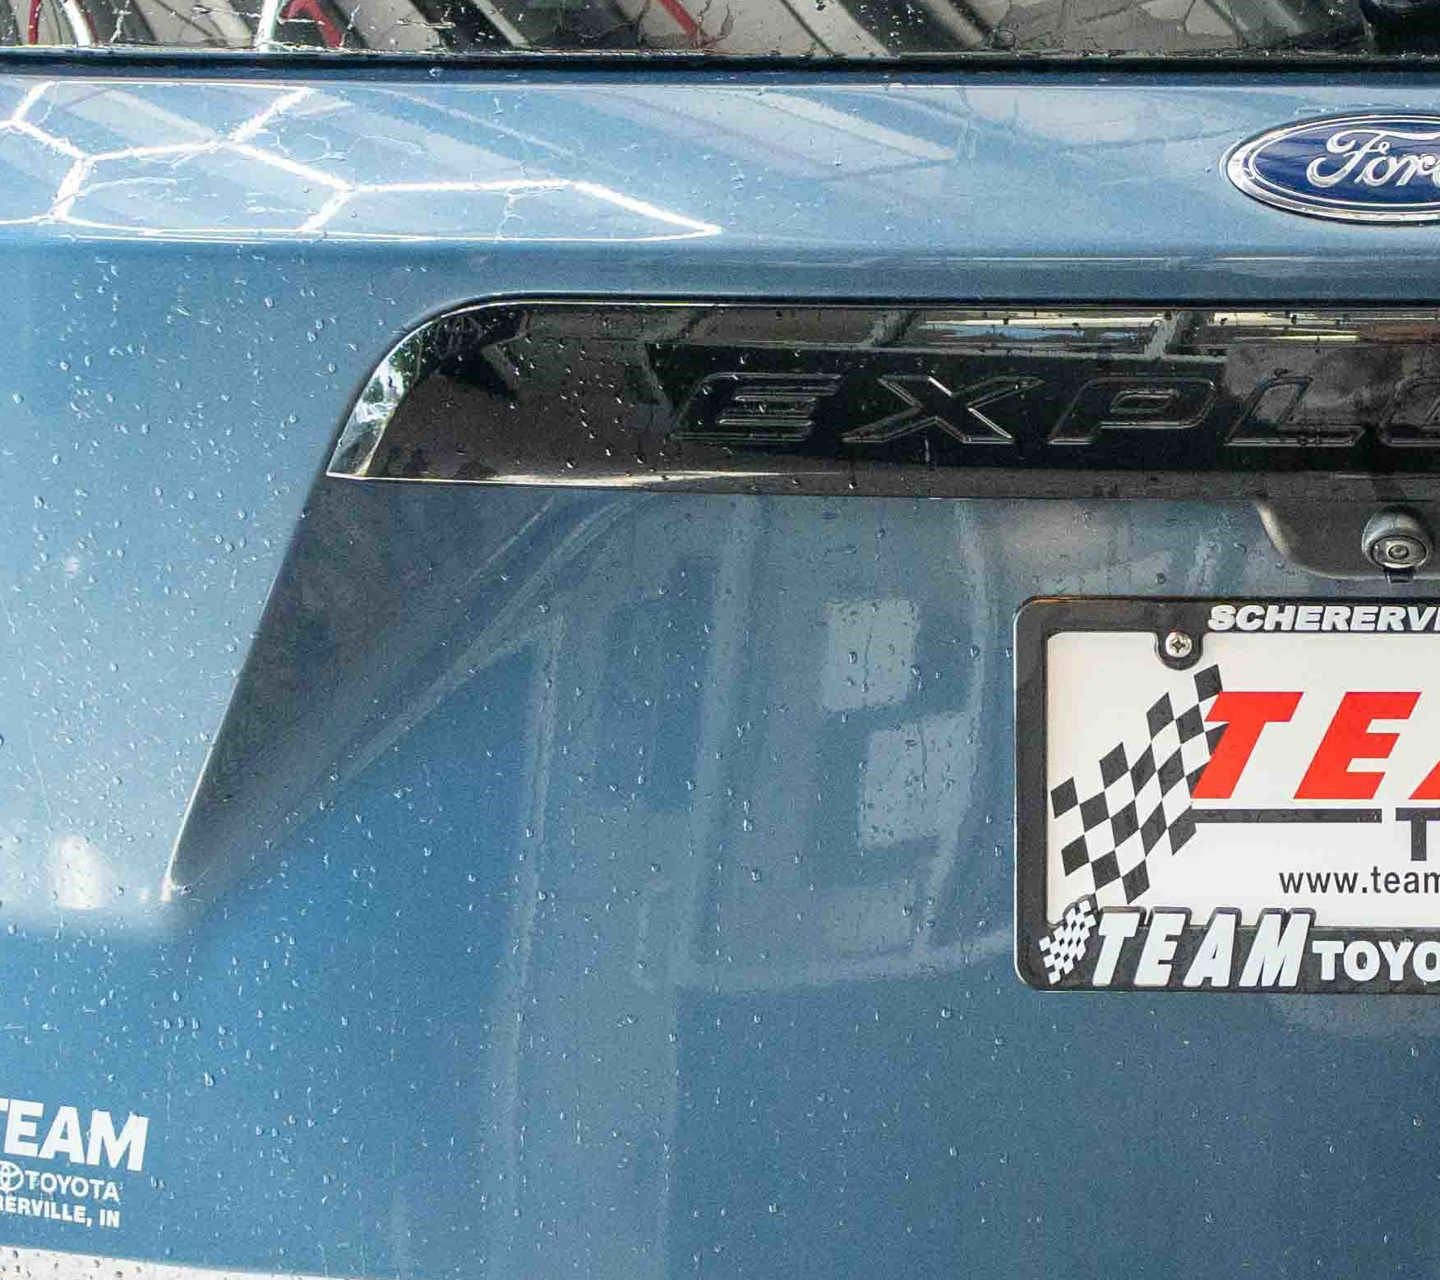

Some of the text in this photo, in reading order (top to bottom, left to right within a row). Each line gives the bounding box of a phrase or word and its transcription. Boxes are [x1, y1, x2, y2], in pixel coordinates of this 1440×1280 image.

[1090, 910, 1314, 987] TEAM
[24, 1170, 120, 1202] TOYOTA
[98, 1208, 120, 1228] IN
